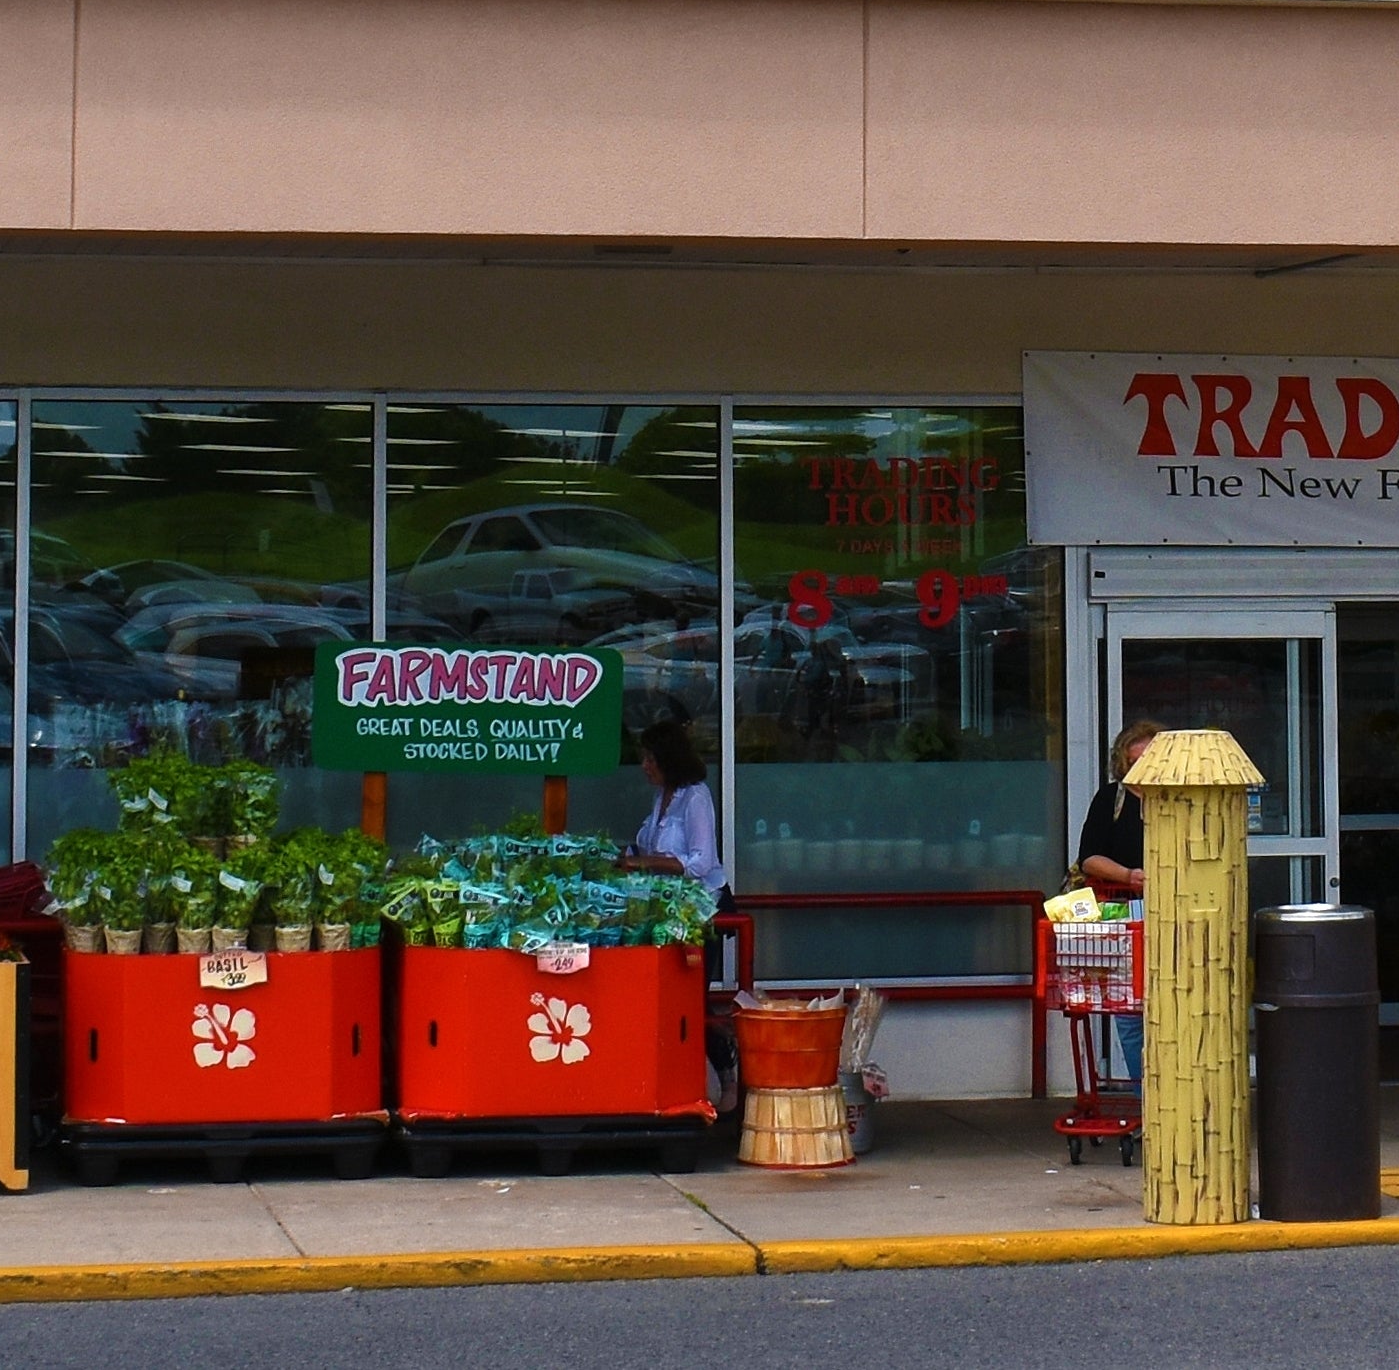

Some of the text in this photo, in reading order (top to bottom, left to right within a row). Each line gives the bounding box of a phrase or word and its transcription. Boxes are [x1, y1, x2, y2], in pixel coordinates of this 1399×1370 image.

[802, 456, 1000, 490] TRADING
[1156, 464, 1243, 500] The
[1258, 467, 1363, 501] New
[824, 493, 978, 527] HOURS
[788, 569, 834, 629] 8
[916, 568, 961, 628] 9
[340, 648, 600, 706] FARMSTAND
[356, 717, 415, 738] GREAT
[489, 719, 570, 742] QUALITY
[572, 721, 585, 739] &
[403, 741, 561, 763] STOCKED DAILY!
[207, 957, 249, 974] BASIL
